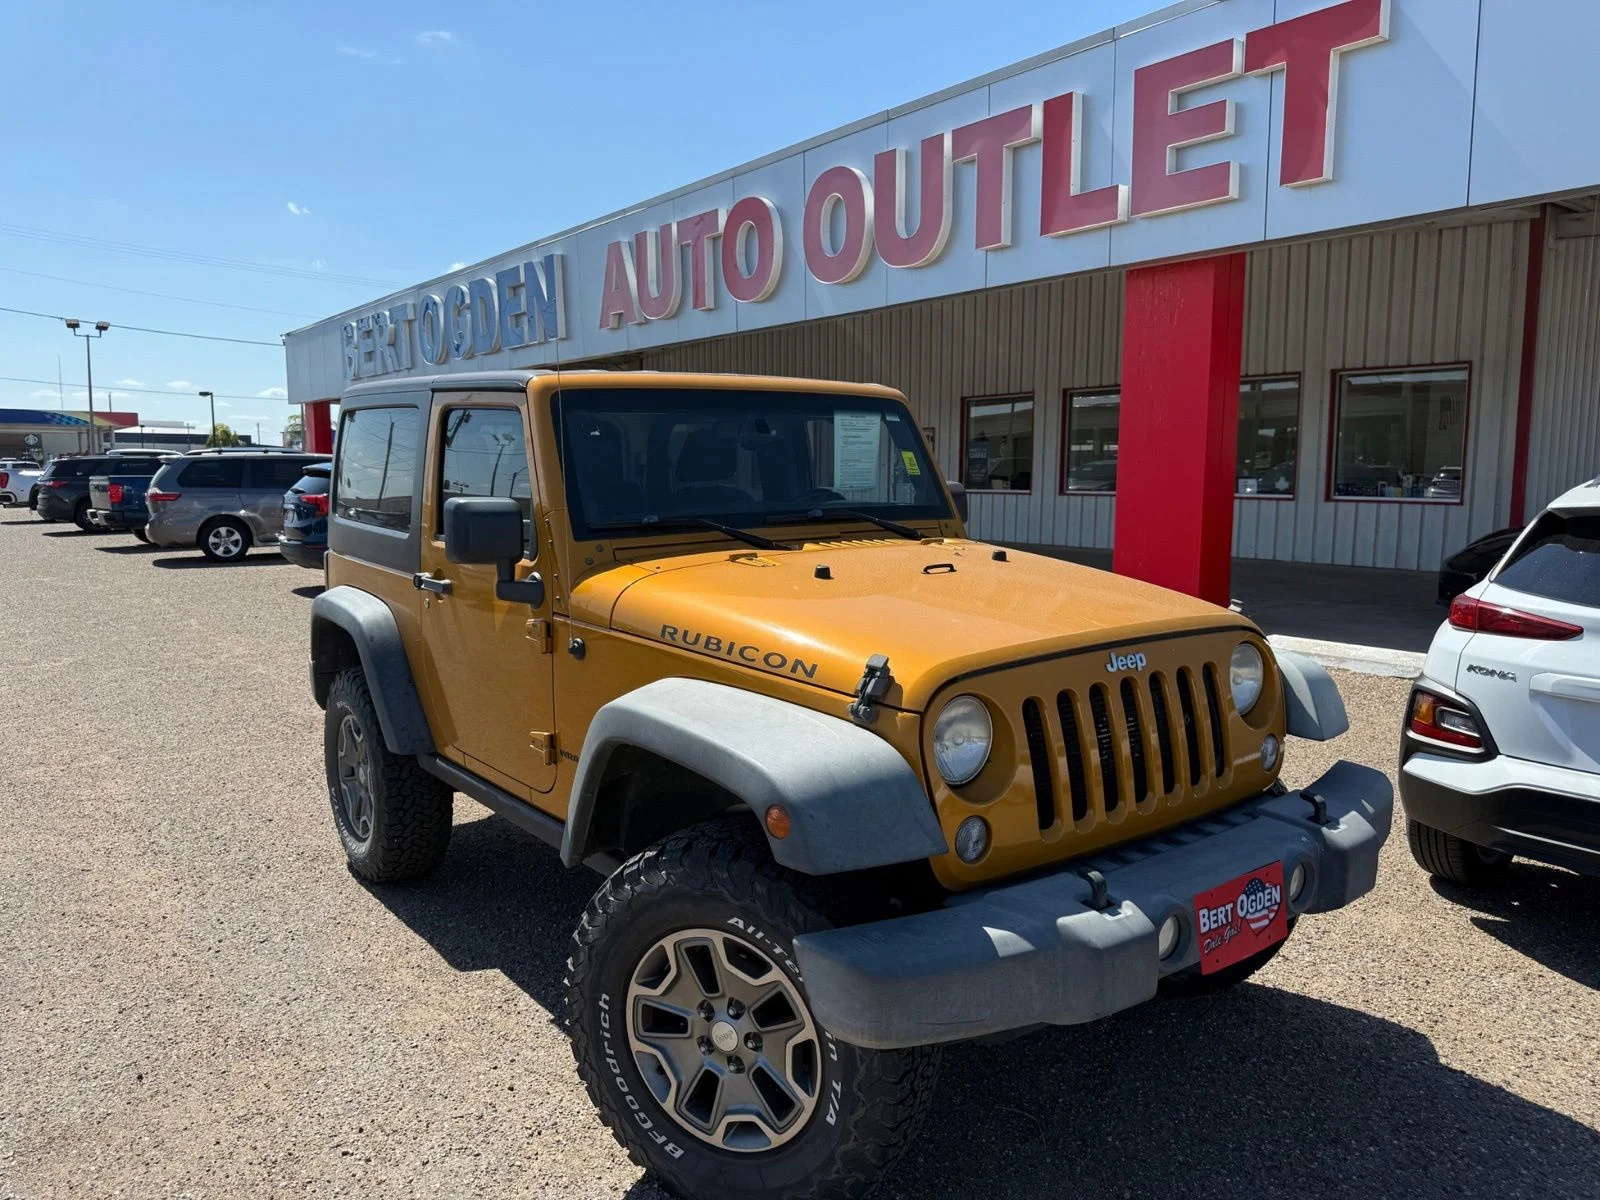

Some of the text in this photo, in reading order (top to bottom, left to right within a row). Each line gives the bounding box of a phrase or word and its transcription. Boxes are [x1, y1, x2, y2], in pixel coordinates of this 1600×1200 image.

[342, 0, 1389, 380] BERT OGDEN AUTO OUTLET
[660, 624, 818, 679] RUBICON
[1105, 652, 1147, 672] Jeep
[1466, 664, 1517, 682] KONA
[1199, 885, 1281, 934] BERT OGDEN
[599, 993, 685, 1159] BFGoodrich
[825, 1079, 842, 1126] T/A
